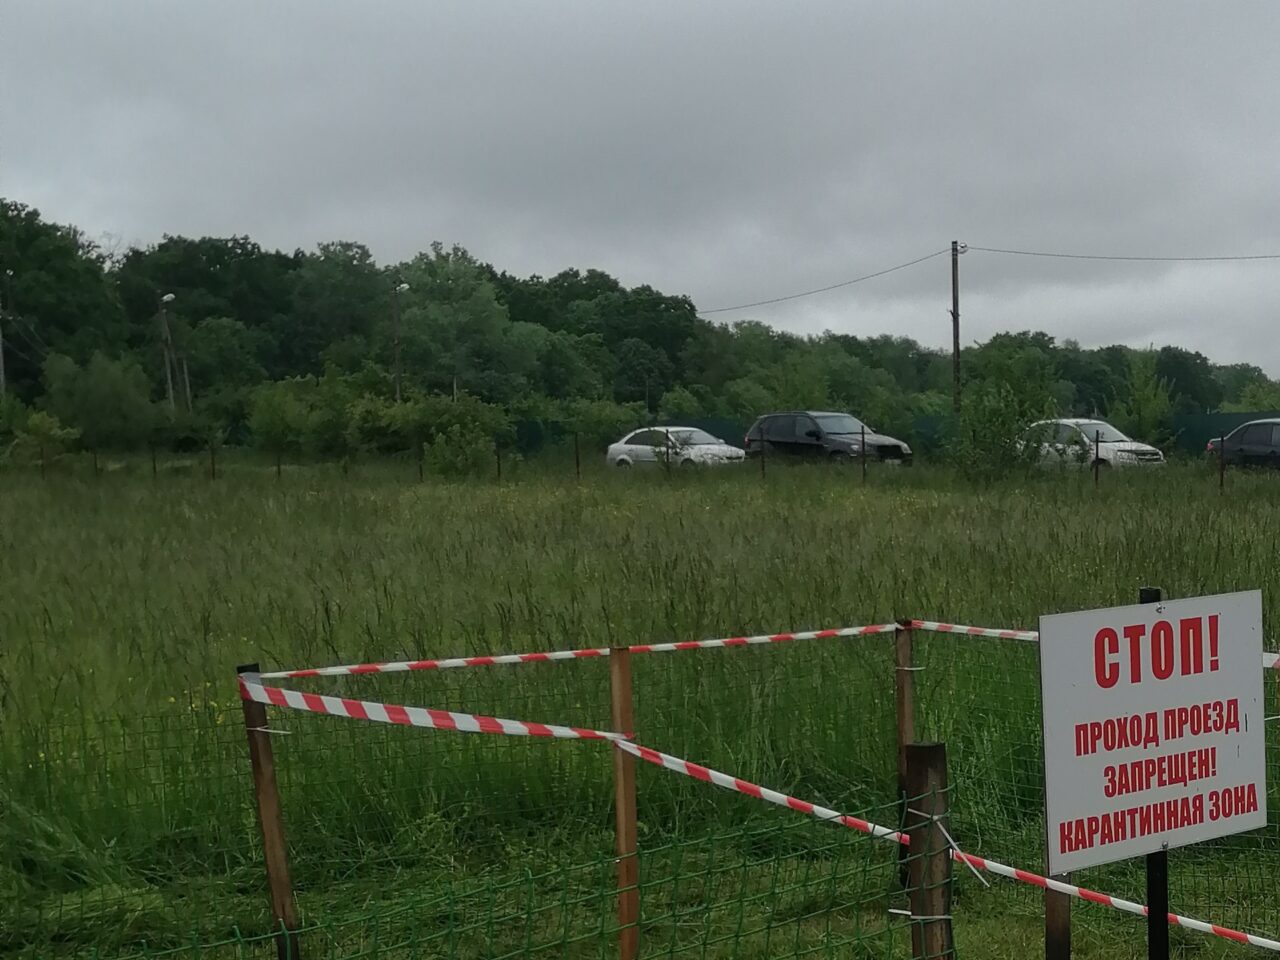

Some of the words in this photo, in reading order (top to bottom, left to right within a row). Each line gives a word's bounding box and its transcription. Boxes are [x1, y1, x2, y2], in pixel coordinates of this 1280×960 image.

[1093, 614, 1220, 689] СТОП!
[1075, 711, 1160, 756] ПРОХОД
[1163, 698, 1240, 741] ПРОЕЗД
[1103, 747, 1217, 798] ЗАПРЕЩЕН!
[1059, 794, 1205, 854] КАРАНТИННАЯ
[1208, 783, 1259, 821] ЗОНА
